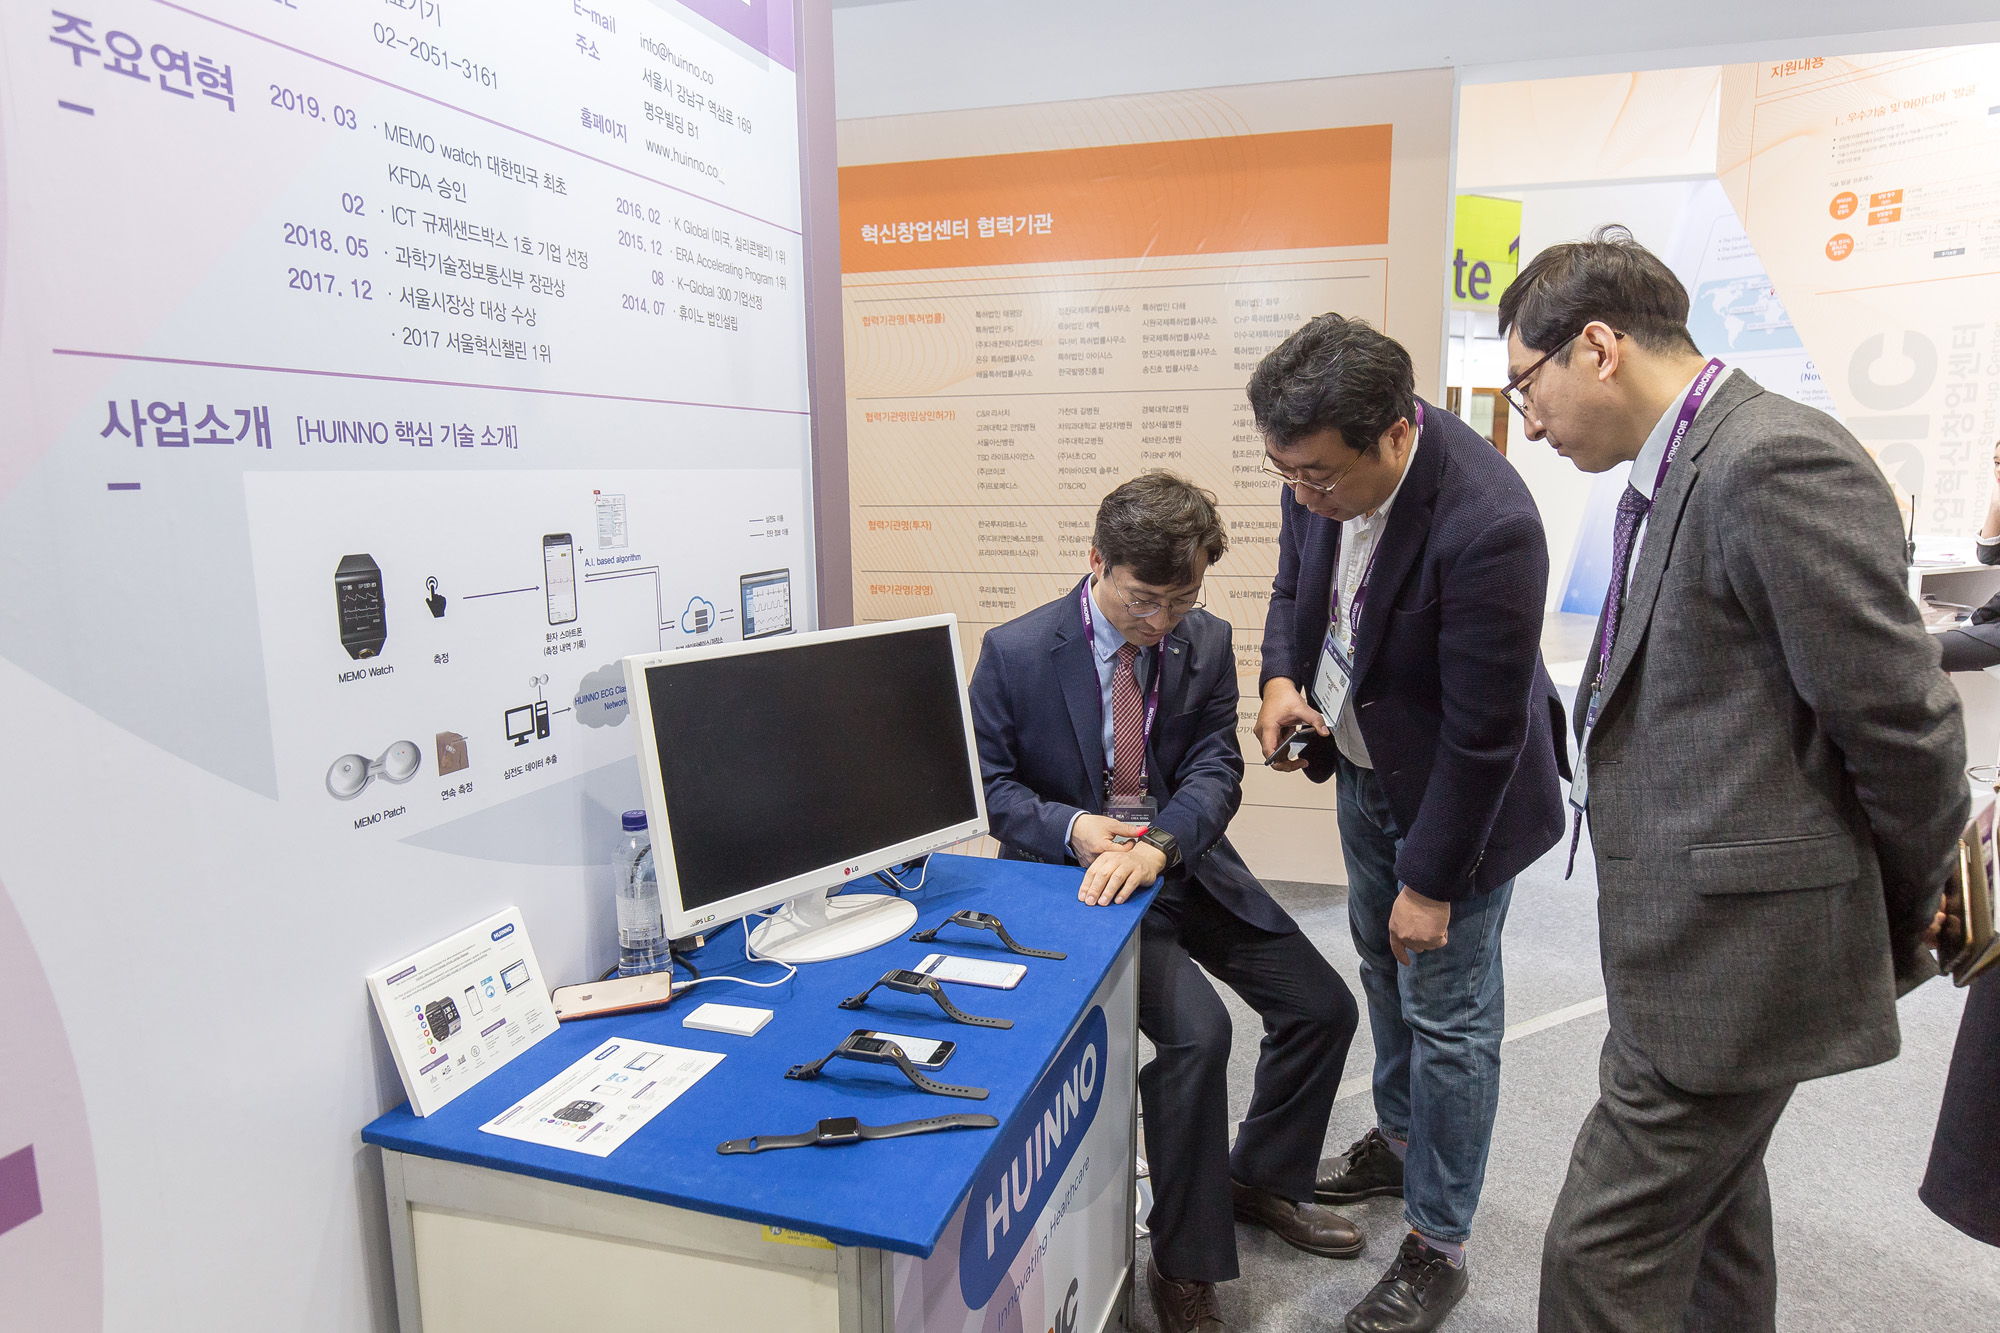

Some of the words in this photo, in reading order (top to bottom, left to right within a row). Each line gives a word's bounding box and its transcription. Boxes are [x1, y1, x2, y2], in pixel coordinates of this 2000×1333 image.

[574, 0, 616, 34] E-mail
[49, 9, 235, 112] 주요연혁
[373, 22, 498, 90] 02-2051-3161
[576, 33, 600, 61] 주소
[639, 33, 714, 85] info@huinno.co
[1771, 57, 1826, 79] 지원내용
[270, 84, 327, 122] 2019.
[333, 105, 358, 130] 03
[642, 68, 673, 97] 서울시
[676, 84, 705, 111] 강남구
[708, 100, 734, 126] 역삼로
[737, 115, 752, 135] 169
[1848, 105, 1886, 123] 우수기술
[1890, 102, 1900, 113] 및
[1904, 91, 1946, 110] 아이디어
[580, 107, 627, 143] 홈페이지
[644, 101, 684, 134] 명우빌딩
[687, 122, 699, 139] B1
[384, 122, 435, 154] MEMO
[440, 144, 482, 169] watch
[487, 155, 539, 188] 대한민국
[543, 172, 567, 195] 최초
[388, 163, 432, 192] KFDA
[437, 177, 467, 203] 승인
[341, 192, 365, 216] 02
[616, 197, 645, 221] 2016.
[648, 208, 661, 225] 02
[283, 222, 338, 254] 2018.
[346, 235, 369, 258] 05
[391, 204, 416, 227] ICT
[422, 212, 509, 249] 규제샌드박스
[513, 234, 534, 256] 1호
[537, 240, 561, 263] 기업
[565, 247, 588, 270] 선정
[674, 216, 681, 232] K
[683, 220, 709, 240] Global
[775, 250, 786, 265] 1위
[861, 218, 970, 245] 혁신창업센터
[977, 212, 1053, 238] 협력기관
[618, 230, 647, 252] 2015.
[650, 239, 662, 256] 12
[395, 246, 525, 290] 과학기술정보통신부
[529, 273, 565, 298] 장관상
[651, 270, 664, 286] 08
[676, 247, 694, 264] ERA
[697, 253, 743, 279] Accelerating
[745, 267, 774, 286] Program
[776, 275, 787, 290] 1위
[288, 267, 343, 297] 2017.
[351, 278, 373, 300] 12
[677, 276, 714, 297] K-Global
[717, 286, 731, 302] 300
[734, 290, 763, 310] 기업선정
[399, 286, 475, 318] 서울시장상
[480, 300, 506, 322] 대상
[511, 307, 536, 327] 수상
[622, 293, 650, 315] 2014.
[653, 300, 665, 316] 07
[679, 305, 705, 324] 휴이노
[707, 311, 738, 332] 법인설립
[862, 312, 946, 327] 협력기관명(특허법률)
[402, 327, 440, 349] 2017
[446, 332, 527, 361] 서울혁신챌린
[532, 344, 551, 364] 1위
[1707, 364, 1719, 376] BIO
[1693, 373, 1714, 396] KOREA
[865, 410, 956, 423] 협력기관명(임상인허가)
[1141, 404, 1189, 414] 경북대학교병원
[100, 398, 272, 449] 사업소개
[295, 415, 389, 446] [HUINNO
[394, 420, 434, 448] 핵심
[440, 422, 475, 449] 기술
[480, 424, 519, 450] 소개]
[1141, 420, 1182, 429] 삼성서울병원
[1677, 420, 1688, 435] BIO
[1141, 435, 1182, 444] 세브란스병원
[1666, 434, 1683, 463] KOREA
[868, 520, 932, 532] 협력기관명(투자)
[596, 556, 615, 566] based
[616, 553, 642, 566] algorithm
[869, 584, 933, 596] 협력기관명(경영)
[545, 631, 558, 643] 환자
[559, 627, 583, 640] 스마트폰
[433, 652, 450, 665] 측정
[338, 671, 367, 684] MEMO
[368, 664, 394, 677] Watch
[574, 691, 600, 706] HUINNO
[601, 688, 614, 699] ECG
[503, 766, 525, 780] 심전도
[525, 760, 544, 774] 데이터
[440, 788, 456, 801] 연속
[458, 781, 473, 795] 측정
[354, 814, 382, 830] MEMO
[383, 805, 406, 821] Patch
[851, 865, 859, 873] LG
[985, 1043, 1097, 1261] HUINNO
[998, 1233, 1048, 1332] Innovating
[1049, 1156, 1091, 1238] Healthcare
